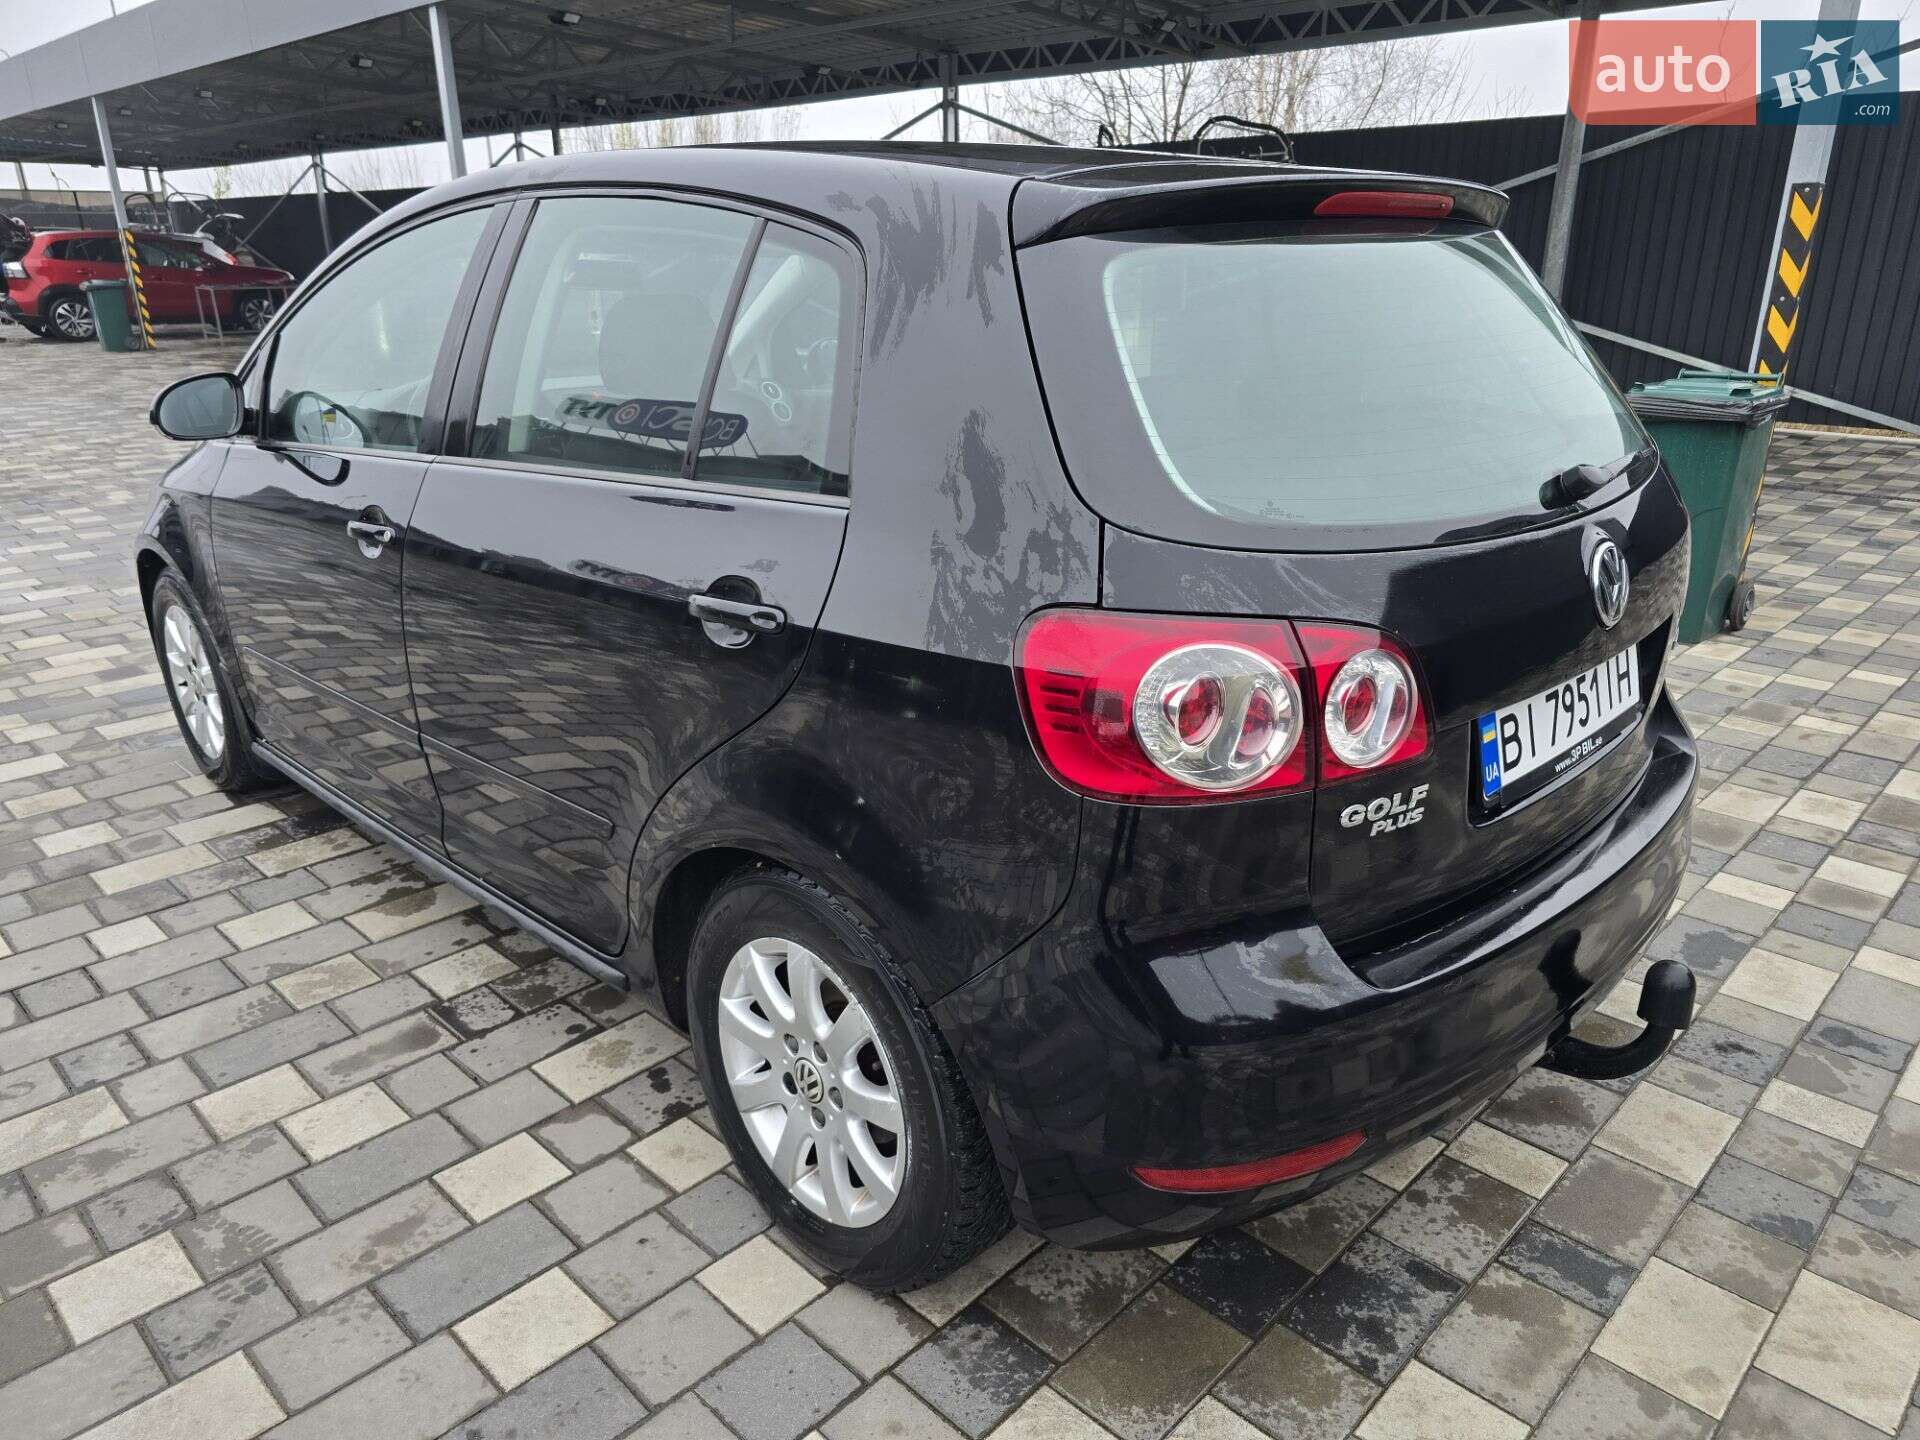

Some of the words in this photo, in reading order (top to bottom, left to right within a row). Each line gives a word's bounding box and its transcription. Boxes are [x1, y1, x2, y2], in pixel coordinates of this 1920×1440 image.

[1499, 704, 1536, 774] BI
[1545, 667, 1601, 747] 7951
[1607, 649, 1632, 710] IH
[1485, 764, 1499, 782] UA
[1340, 783, 1430, 828] GOLF
[1369, 807, 1425, 837] PLUS
